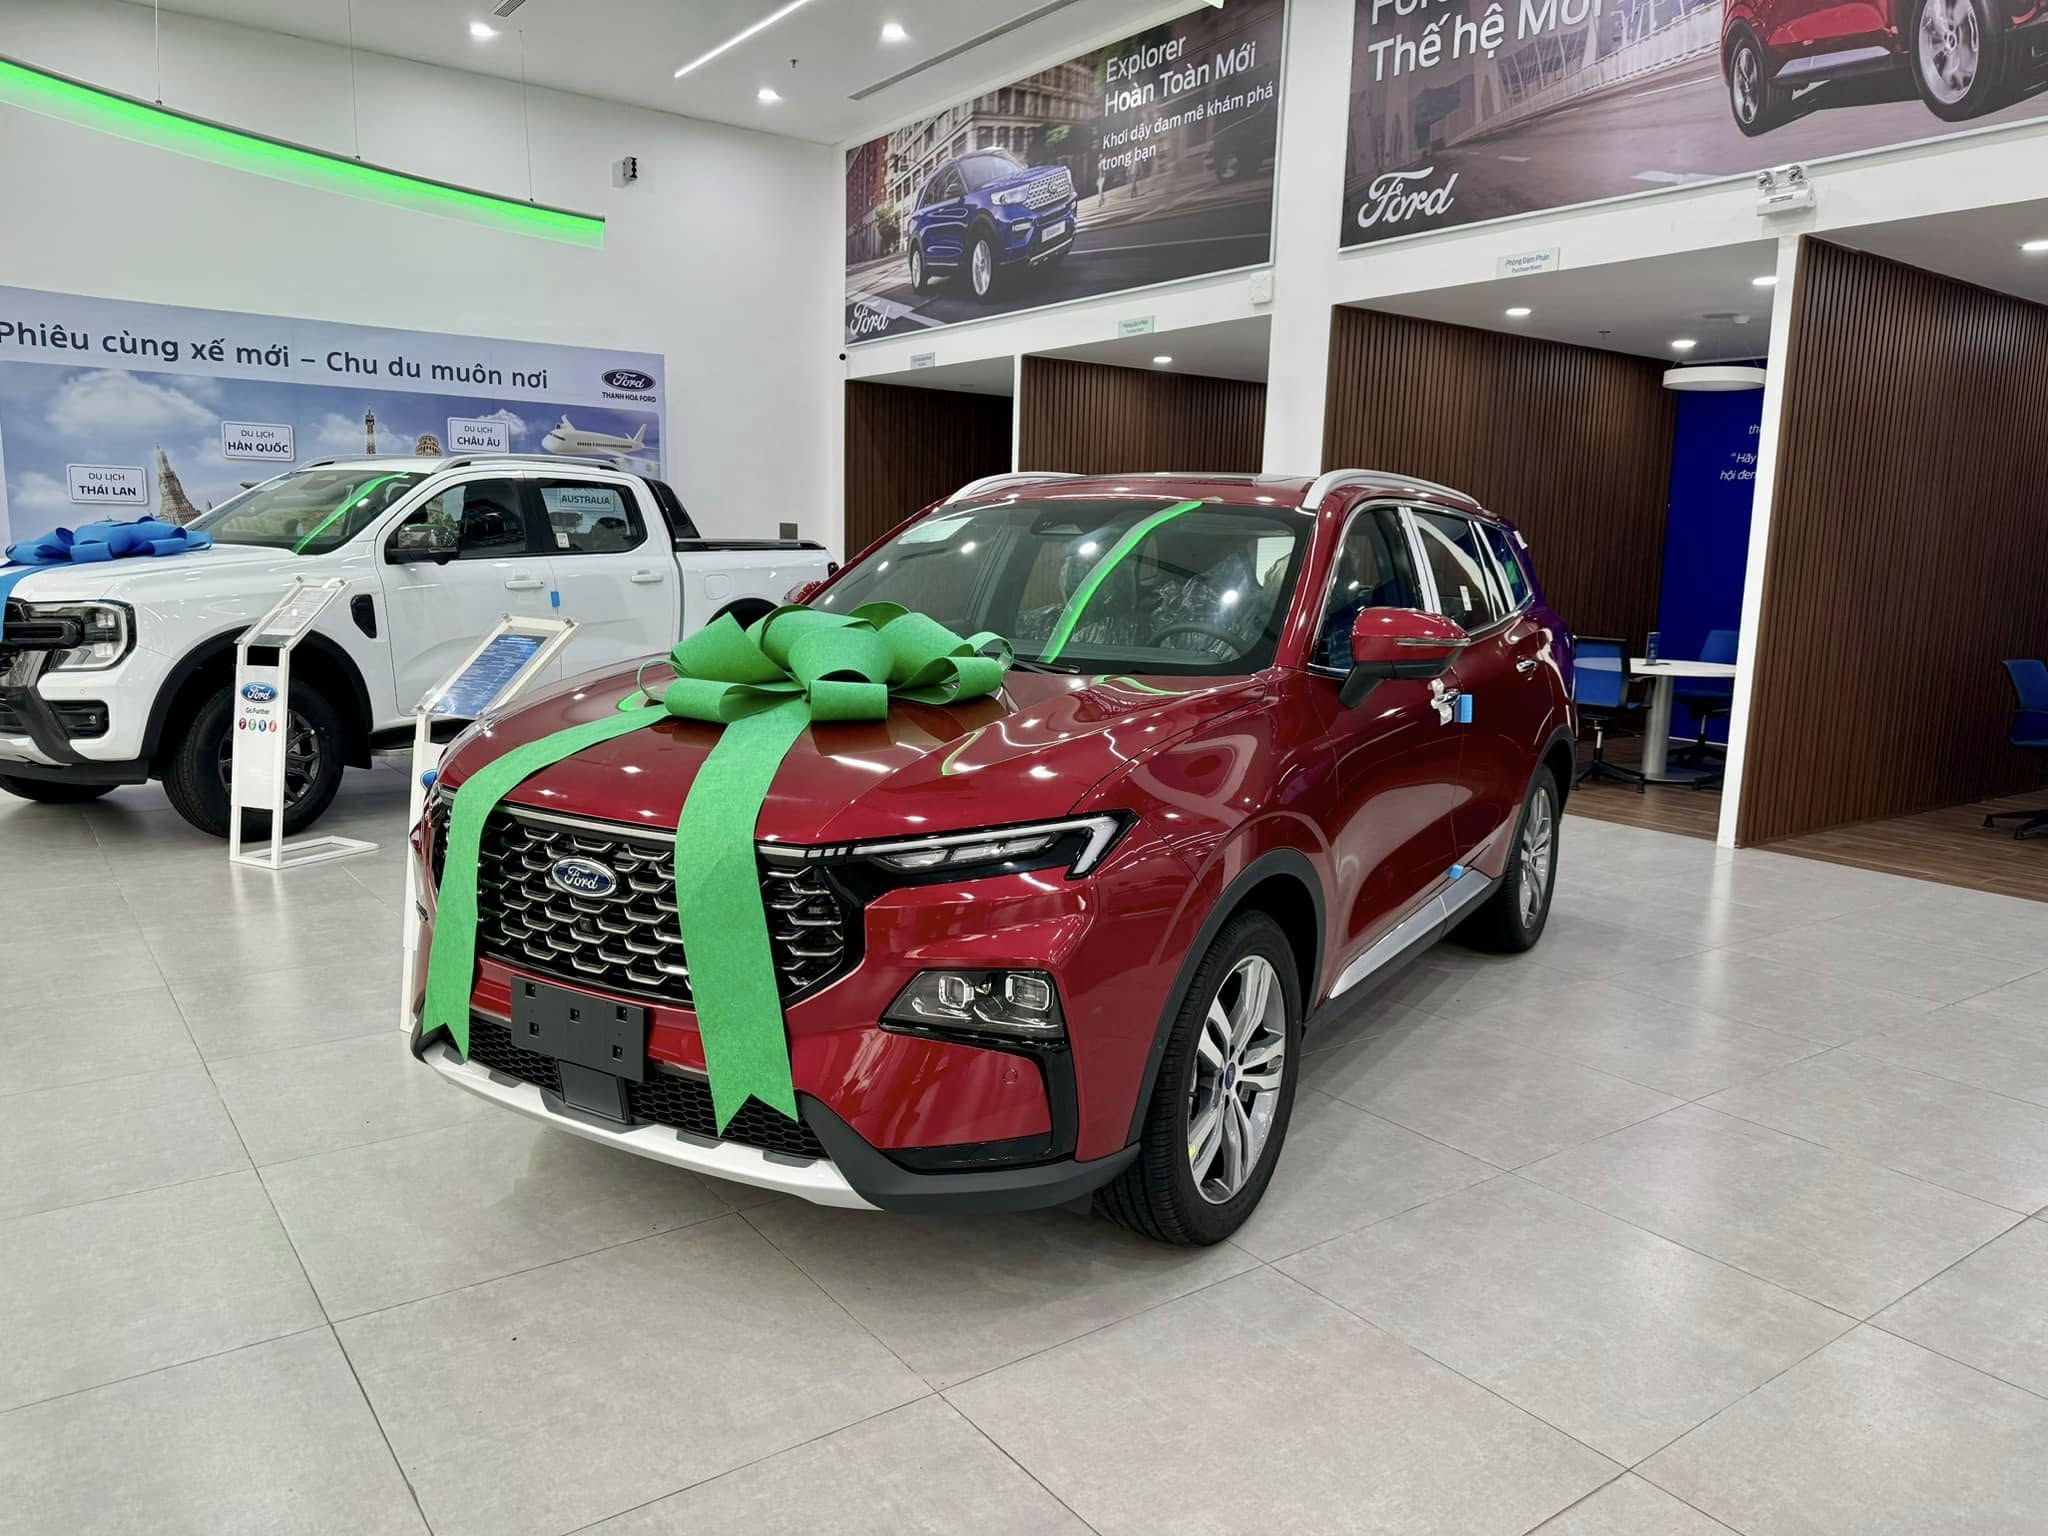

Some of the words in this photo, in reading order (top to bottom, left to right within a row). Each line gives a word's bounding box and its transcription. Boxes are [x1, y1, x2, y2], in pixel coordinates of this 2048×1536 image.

[1368, 12, 1450, 81] Thế
[1452, 3, 1505, 59] hệ
[1106, 35, 1186, 82] Explorer
[1104, 82, 1154, 117] Hoàn
[1159, 62, 1209, 97] Toàn
[1215, 41, 1256, 80] Mới
[1130, 123, 1152, 141] dậy
[1154, 115, 1181, 134] đam
[1184, 105, 1204, 124] mê
[1206, 94, 1243, 117] khám
[1246, 81, 1273, 108] phá
[1101, 149, 1132, 170] trong
[1134, 144, 1156, 162] bạn
[1358, 166, 1459, 228] Ford
[850, 300, 890, 335] Ford
[0, 321, 89, 350] Phiêu
[102, 330, 179, 362] cùng
[191, 338, 226, 362] xế
[236, 344, 289, 368] mới
[327, 351, 377, 375] Chu
[388, 356, 421, 379] du
[431, 363, 502, 386] muôn
[512, 369, 548, 389] nơi
[612, 372, 645, 388] Ford
[601, 391, 625, 400] THANH
[464, 425, 475, 433] DU
[228, 440, 253, 451] HÀN
[256, 441, 289, 454] QUỐC
[457, 435, 484, 447] CHÂU
[487, 437, 500, 447] ÂU
[88, 472, 102, 480] DU
[105, 473, 125, 482] LỊCH
[79, 484, 108, 496] THÁI
[113, 486, 136, 496] LAN
[561, 495, 610, 505] AUSTRALIA
[247, 685, 272, 700] Ford
[564, 865, 599, 889] Ford
